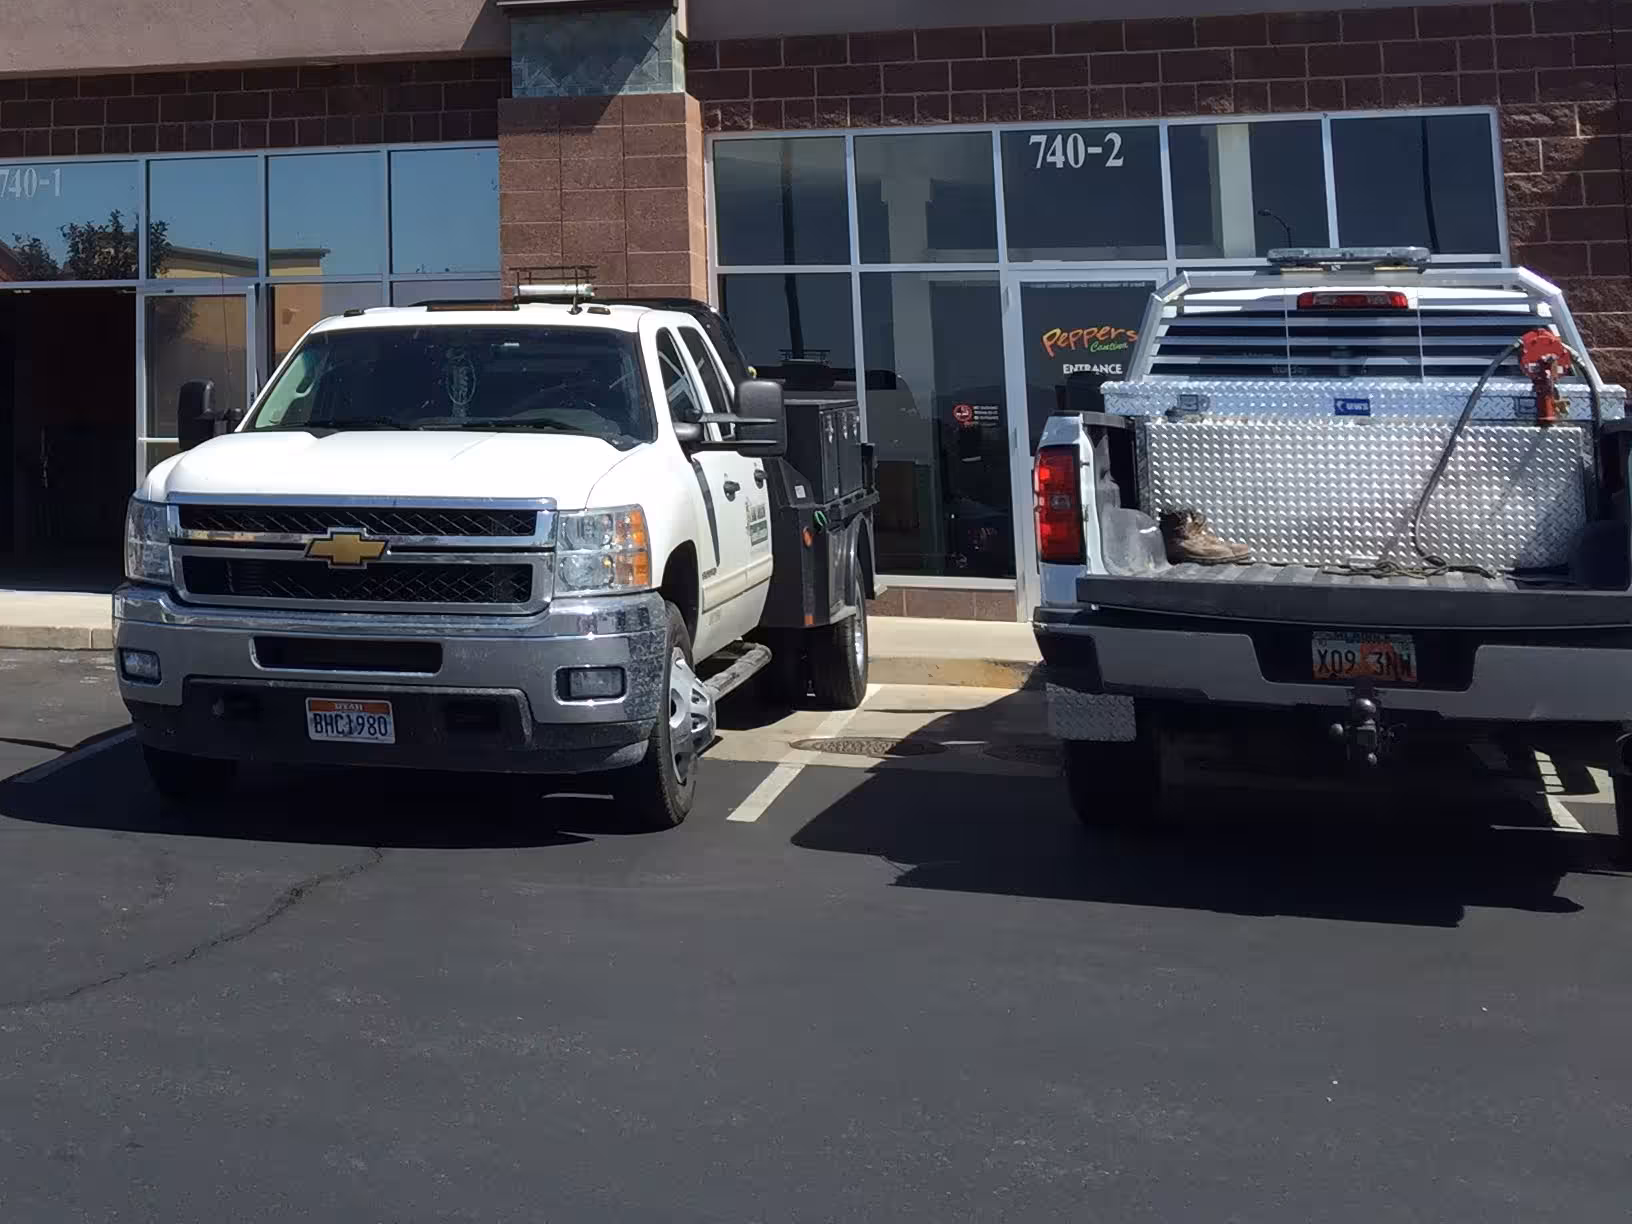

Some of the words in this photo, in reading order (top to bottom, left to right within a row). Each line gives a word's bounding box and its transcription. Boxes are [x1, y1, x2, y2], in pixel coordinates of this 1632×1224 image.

[1028, 132, 1124, 169] 740-2
[1090, 341, 1128, 353] Cantina
[1063, 364, 1123, 375] ENTRANCE
